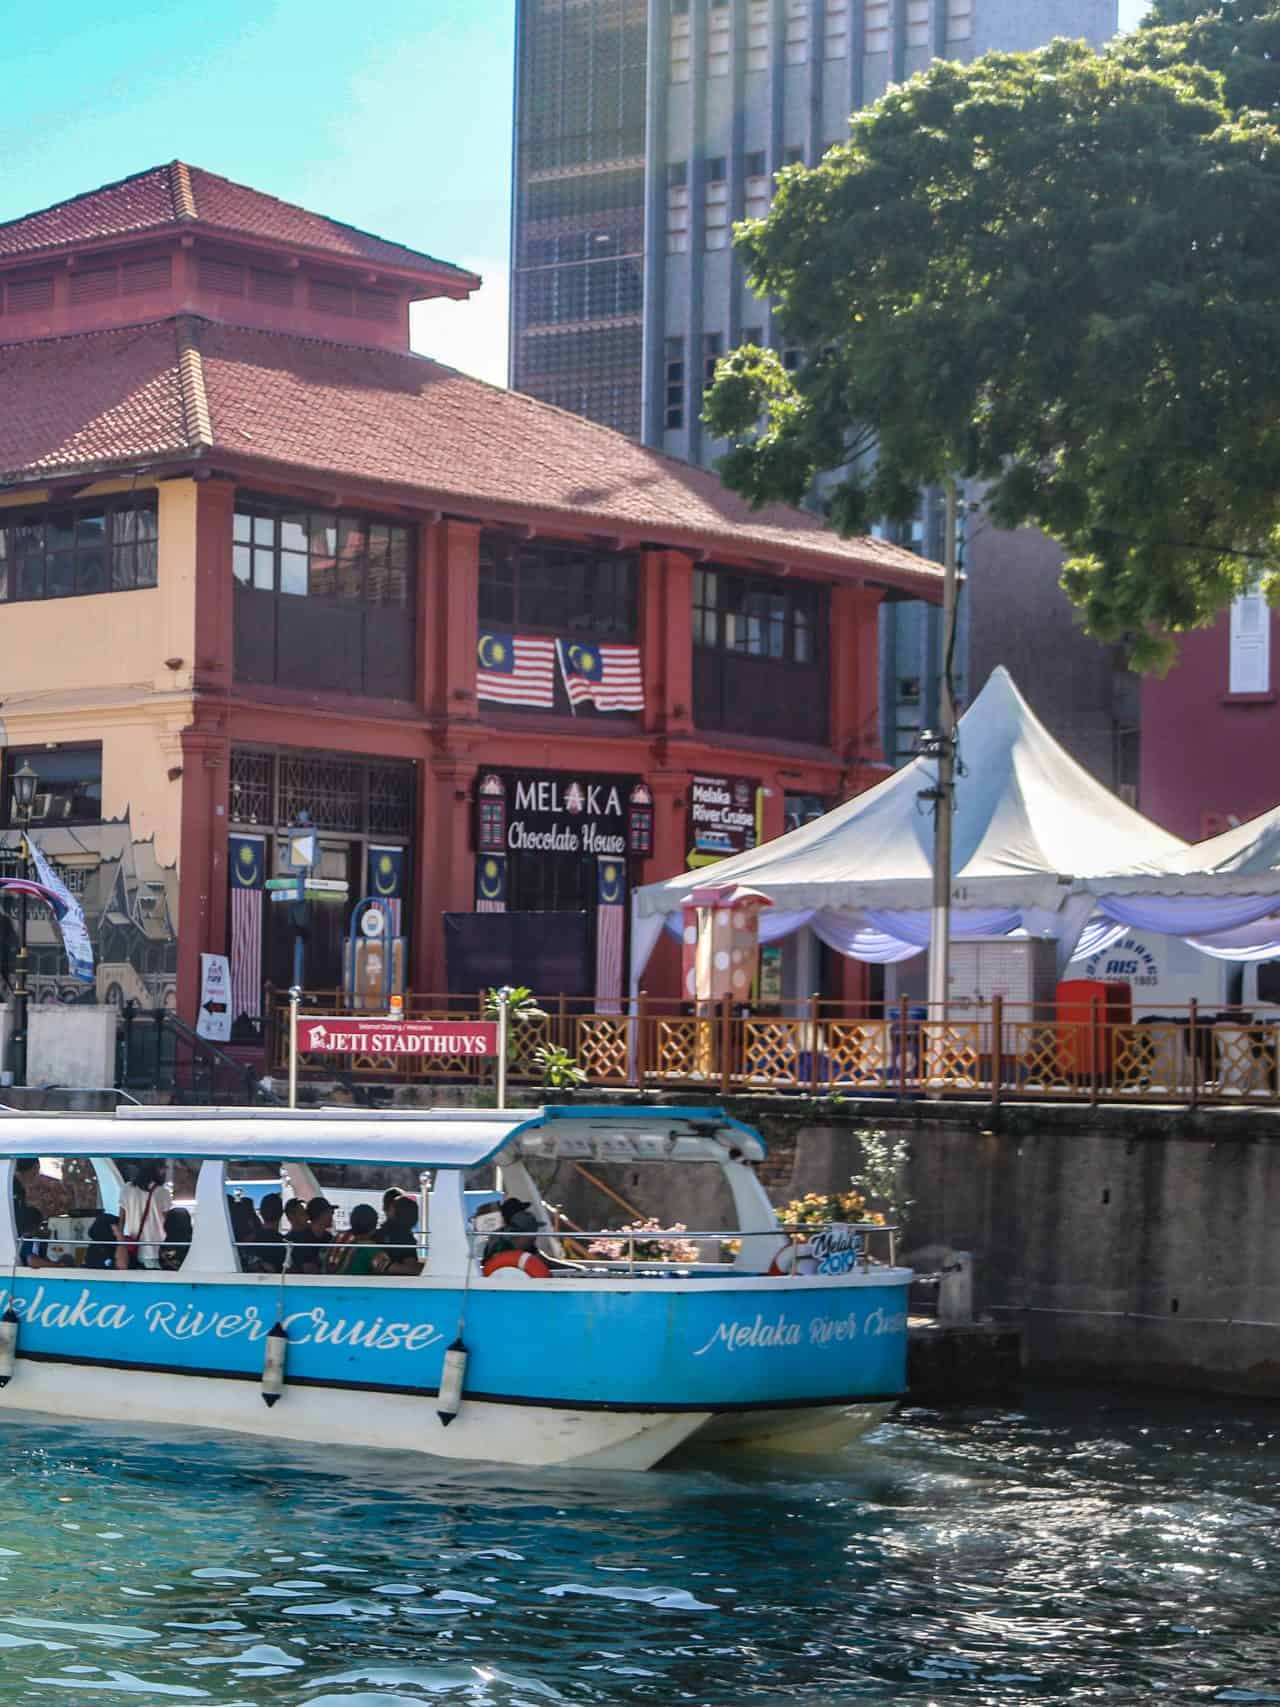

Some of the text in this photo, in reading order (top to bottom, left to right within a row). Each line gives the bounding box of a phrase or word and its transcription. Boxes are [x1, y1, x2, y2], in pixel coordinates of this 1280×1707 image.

[515, 780, 623, 816] MELAKA
[692, 785, 731, 806] Melaka
[692, 803, 754, 827] River Cruise
[507, 820, 626, 853] Chocolate House
[325, 1033, 487, 1054] JETI STADTHUYS
[145, 1301, 272, 1341] River
[282, 1307, 444, 1350] Cruise
[692, 1312, 801, 1356] Melaka
[808, 1312, 857, 1349] River
